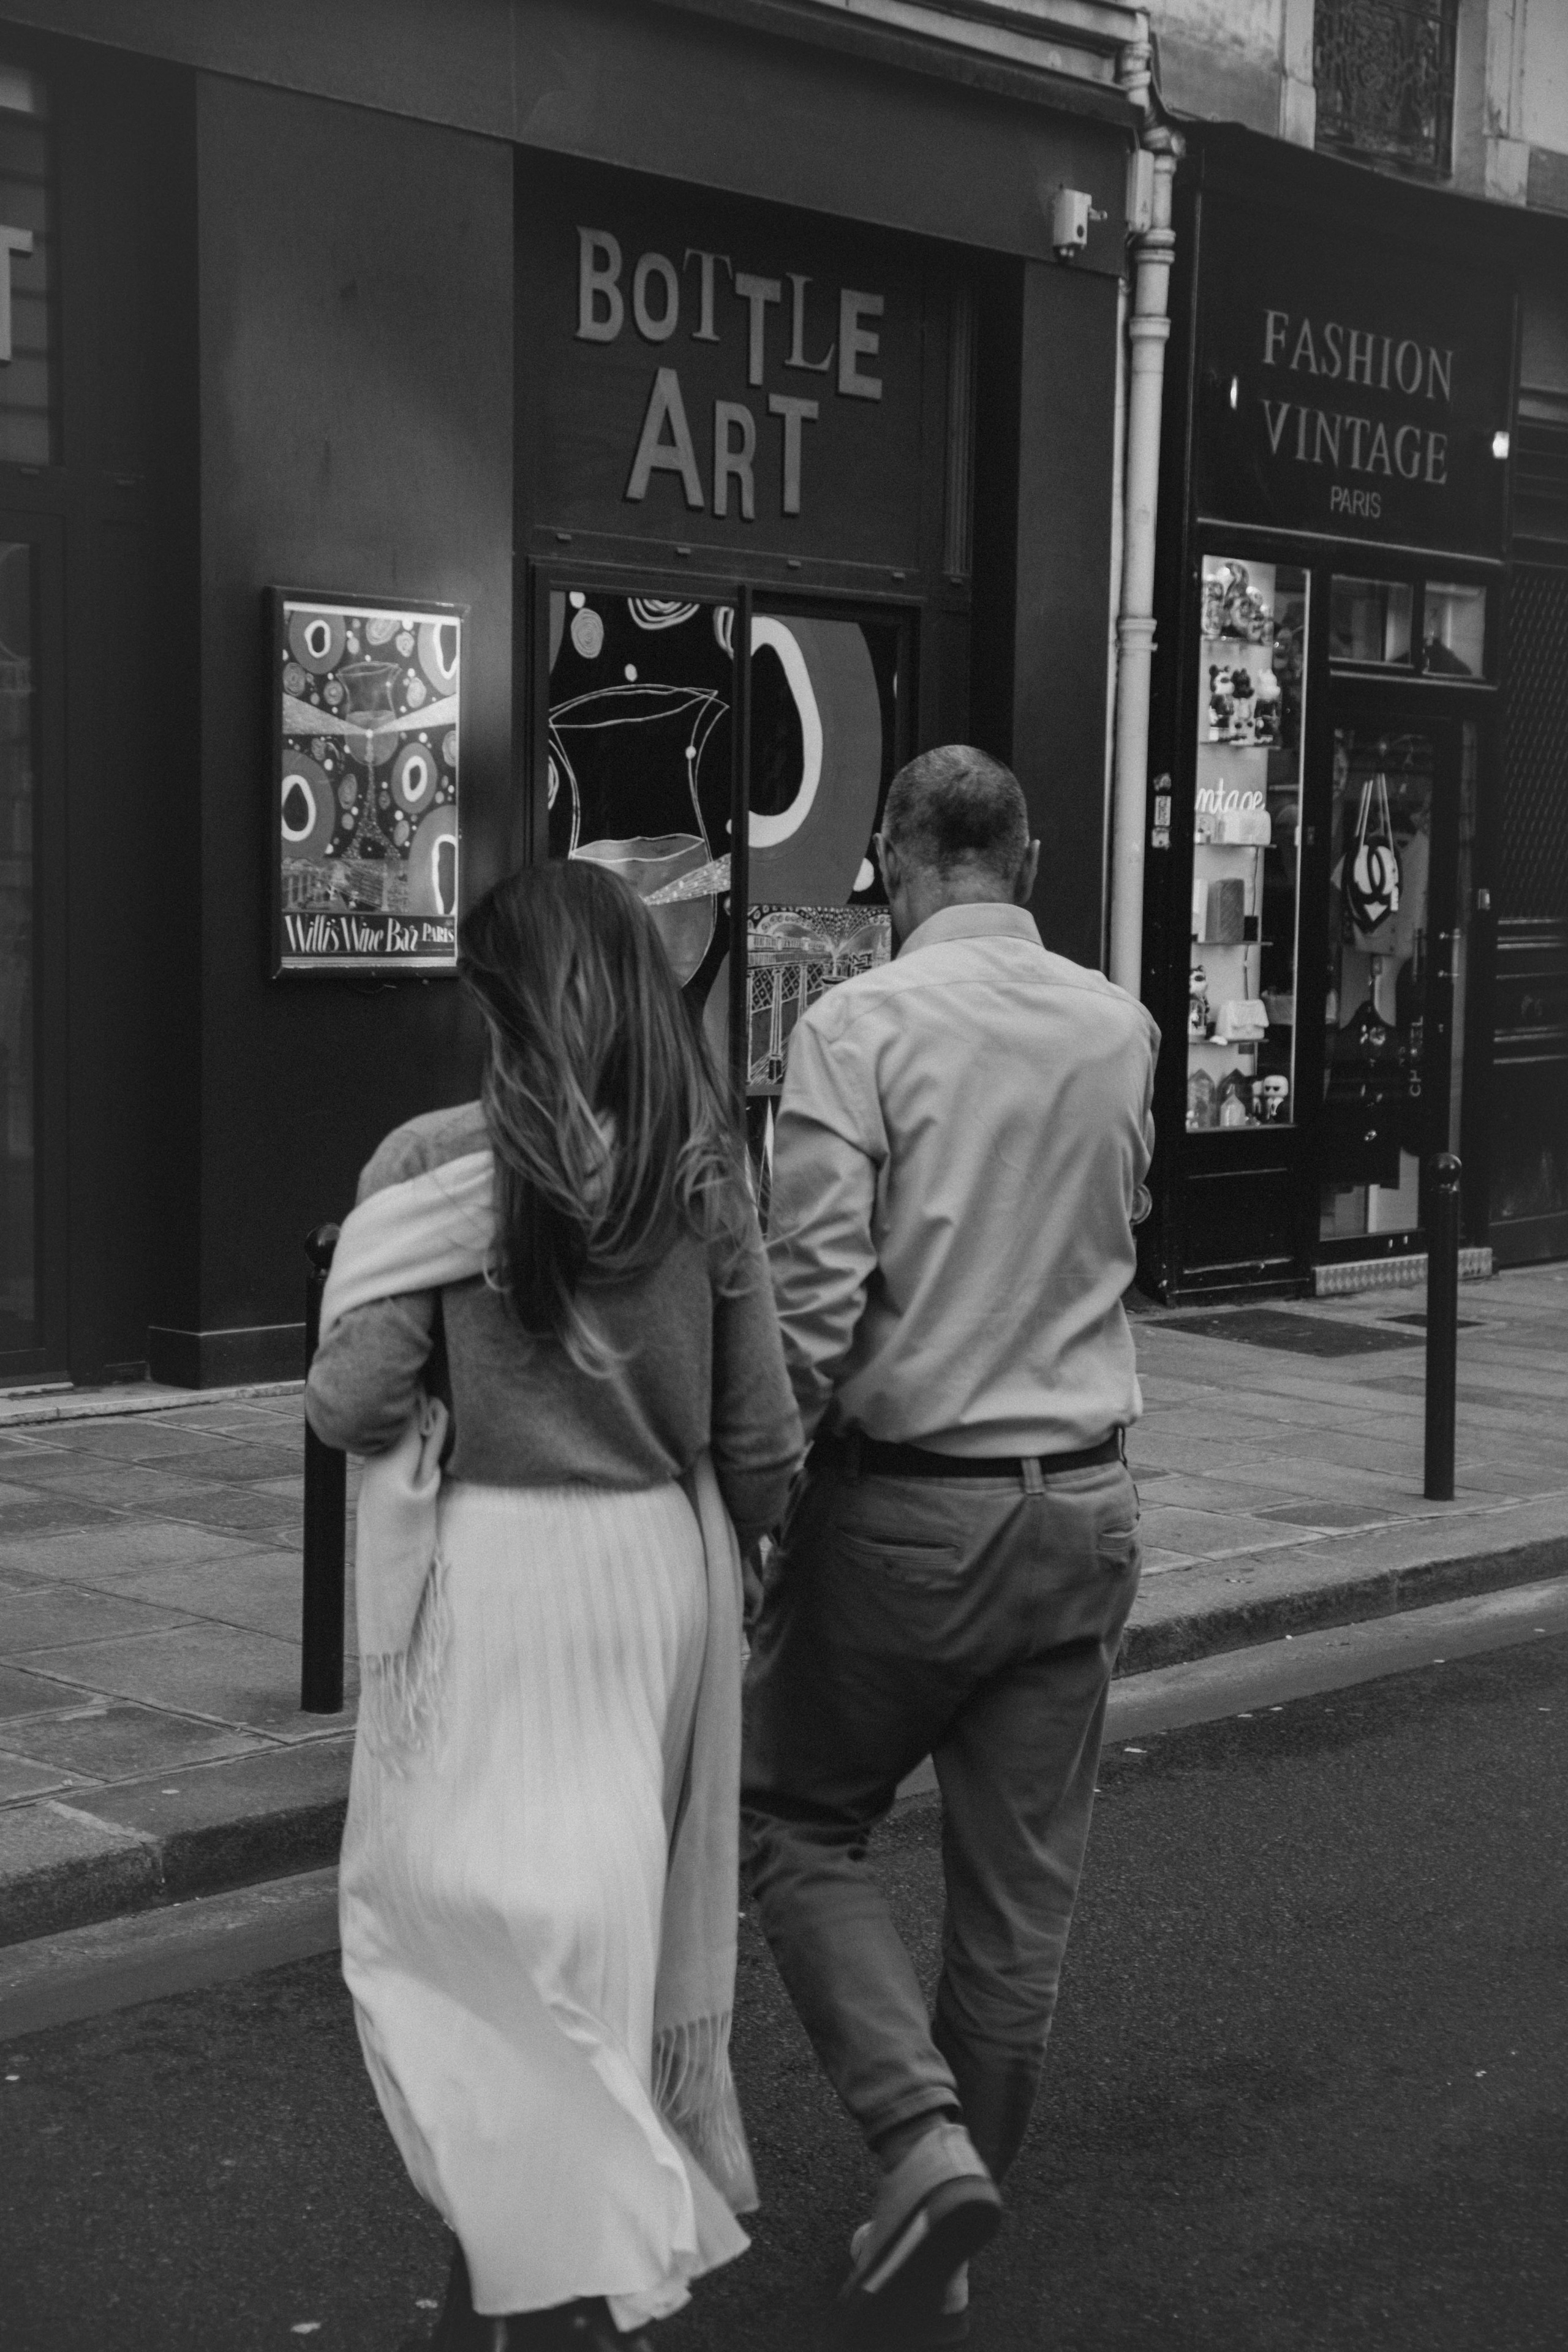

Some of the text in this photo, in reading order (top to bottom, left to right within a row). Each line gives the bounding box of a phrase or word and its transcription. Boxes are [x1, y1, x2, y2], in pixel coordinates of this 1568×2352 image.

[575, 225, 885, 400] BOTTLE
[1262, 309, 1453, 402] FASHION
[624, 367, 820, 520] ART
[1260, 398, 1448, 484] VINTAGE
[1330, 485, 1382, 519] PARIS
[341, 916, 385, 952] Wine
[385, 918, 419, 952] Bar
